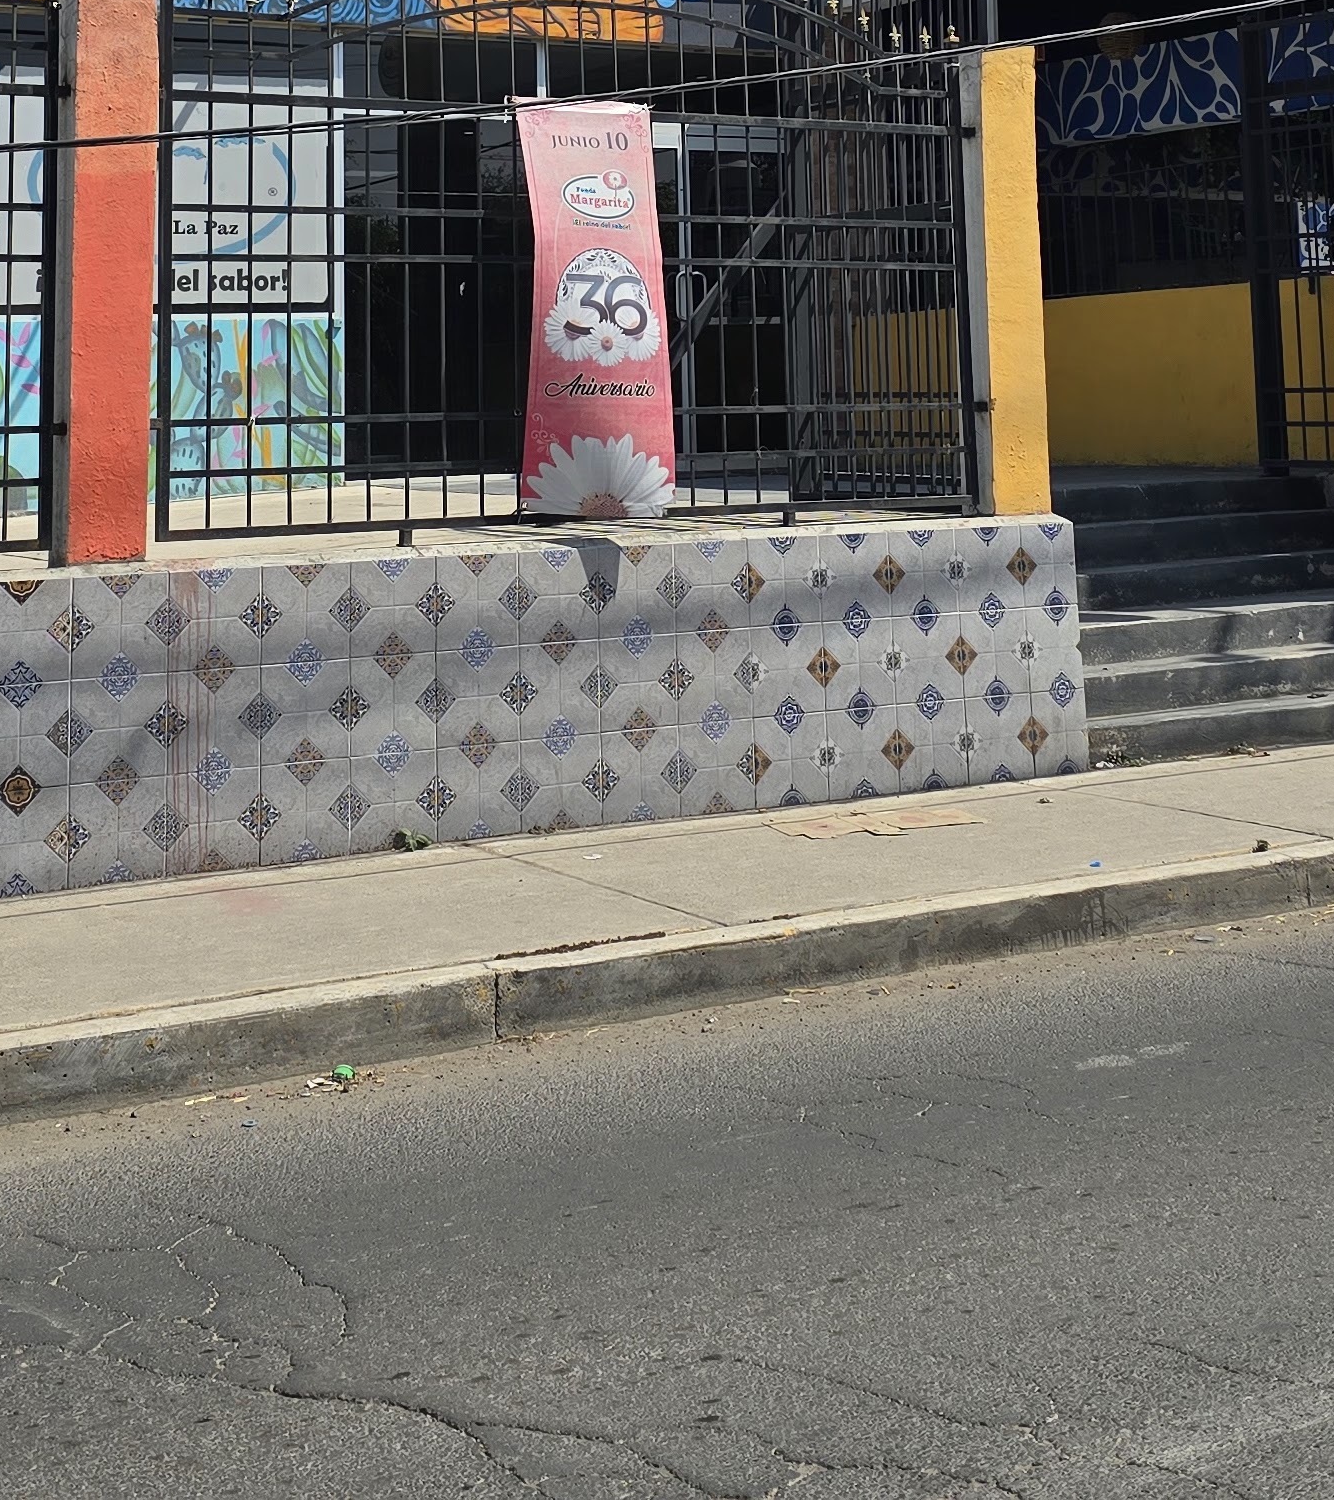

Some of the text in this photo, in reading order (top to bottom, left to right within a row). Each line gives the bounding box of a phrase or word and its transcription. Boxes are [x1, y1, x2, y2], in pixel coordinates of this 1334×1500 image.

[551, 132, 629, 151] JUNIO 10
[575, 186, 596, 194] Fonda
[570, 193, 630, 209] Margarita
[172, 220, 239, 236] La Paz
[562, 273, 648, 337] 36
[544, 372, 655, 398] Aniversario
